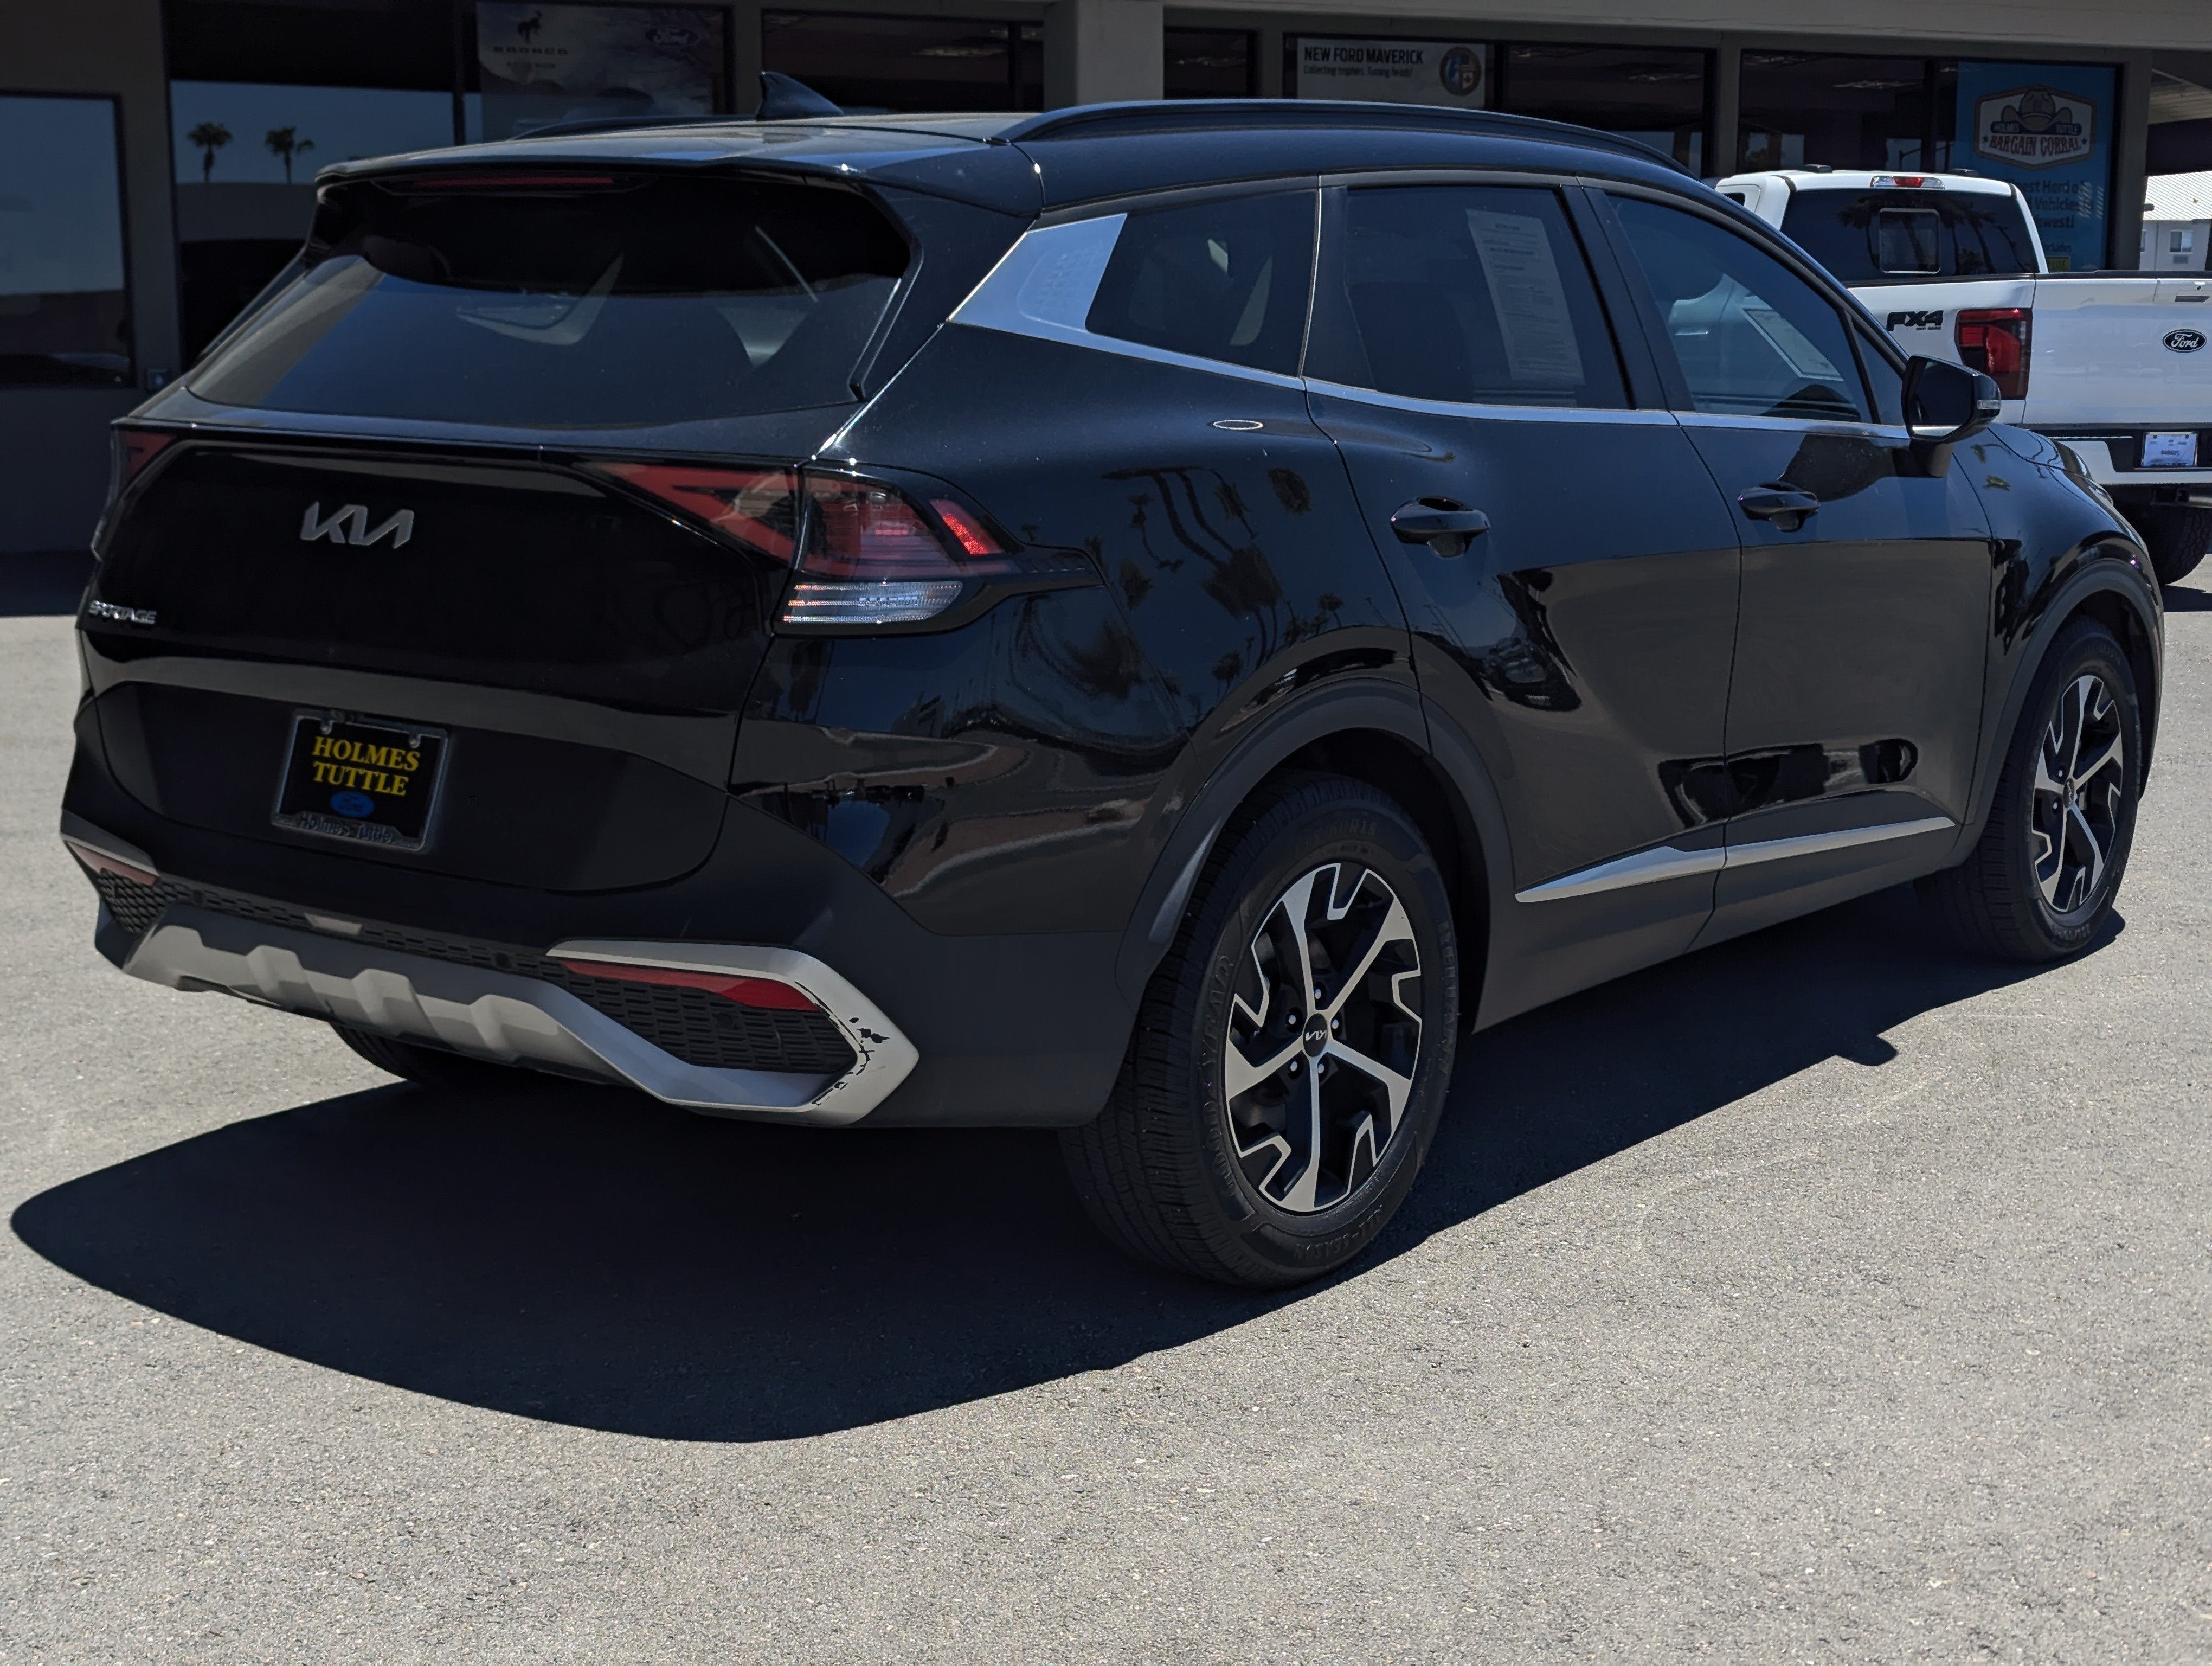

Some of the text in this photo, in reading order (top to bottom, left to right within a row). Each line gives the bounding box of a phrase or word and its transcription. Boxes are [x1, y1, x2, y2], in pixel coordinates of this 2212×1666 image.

[1304, 47, 1423, 65] NEW FORD MAVERICK
[1989, 135, 2081, 156] BARGAIN CORRAL
[1886, 310, 1944, 331] FX4
[2171, 332, 2200, 348] Ford
[300, 501, 414, 549] KIA
[89, 600, 157, 624] SPORTAGE
[312, 736, 421, 772] HOLMES
[313, 761, 409, 797] TUTTLE
[1305, 1029, 1327, 1041] KIA
